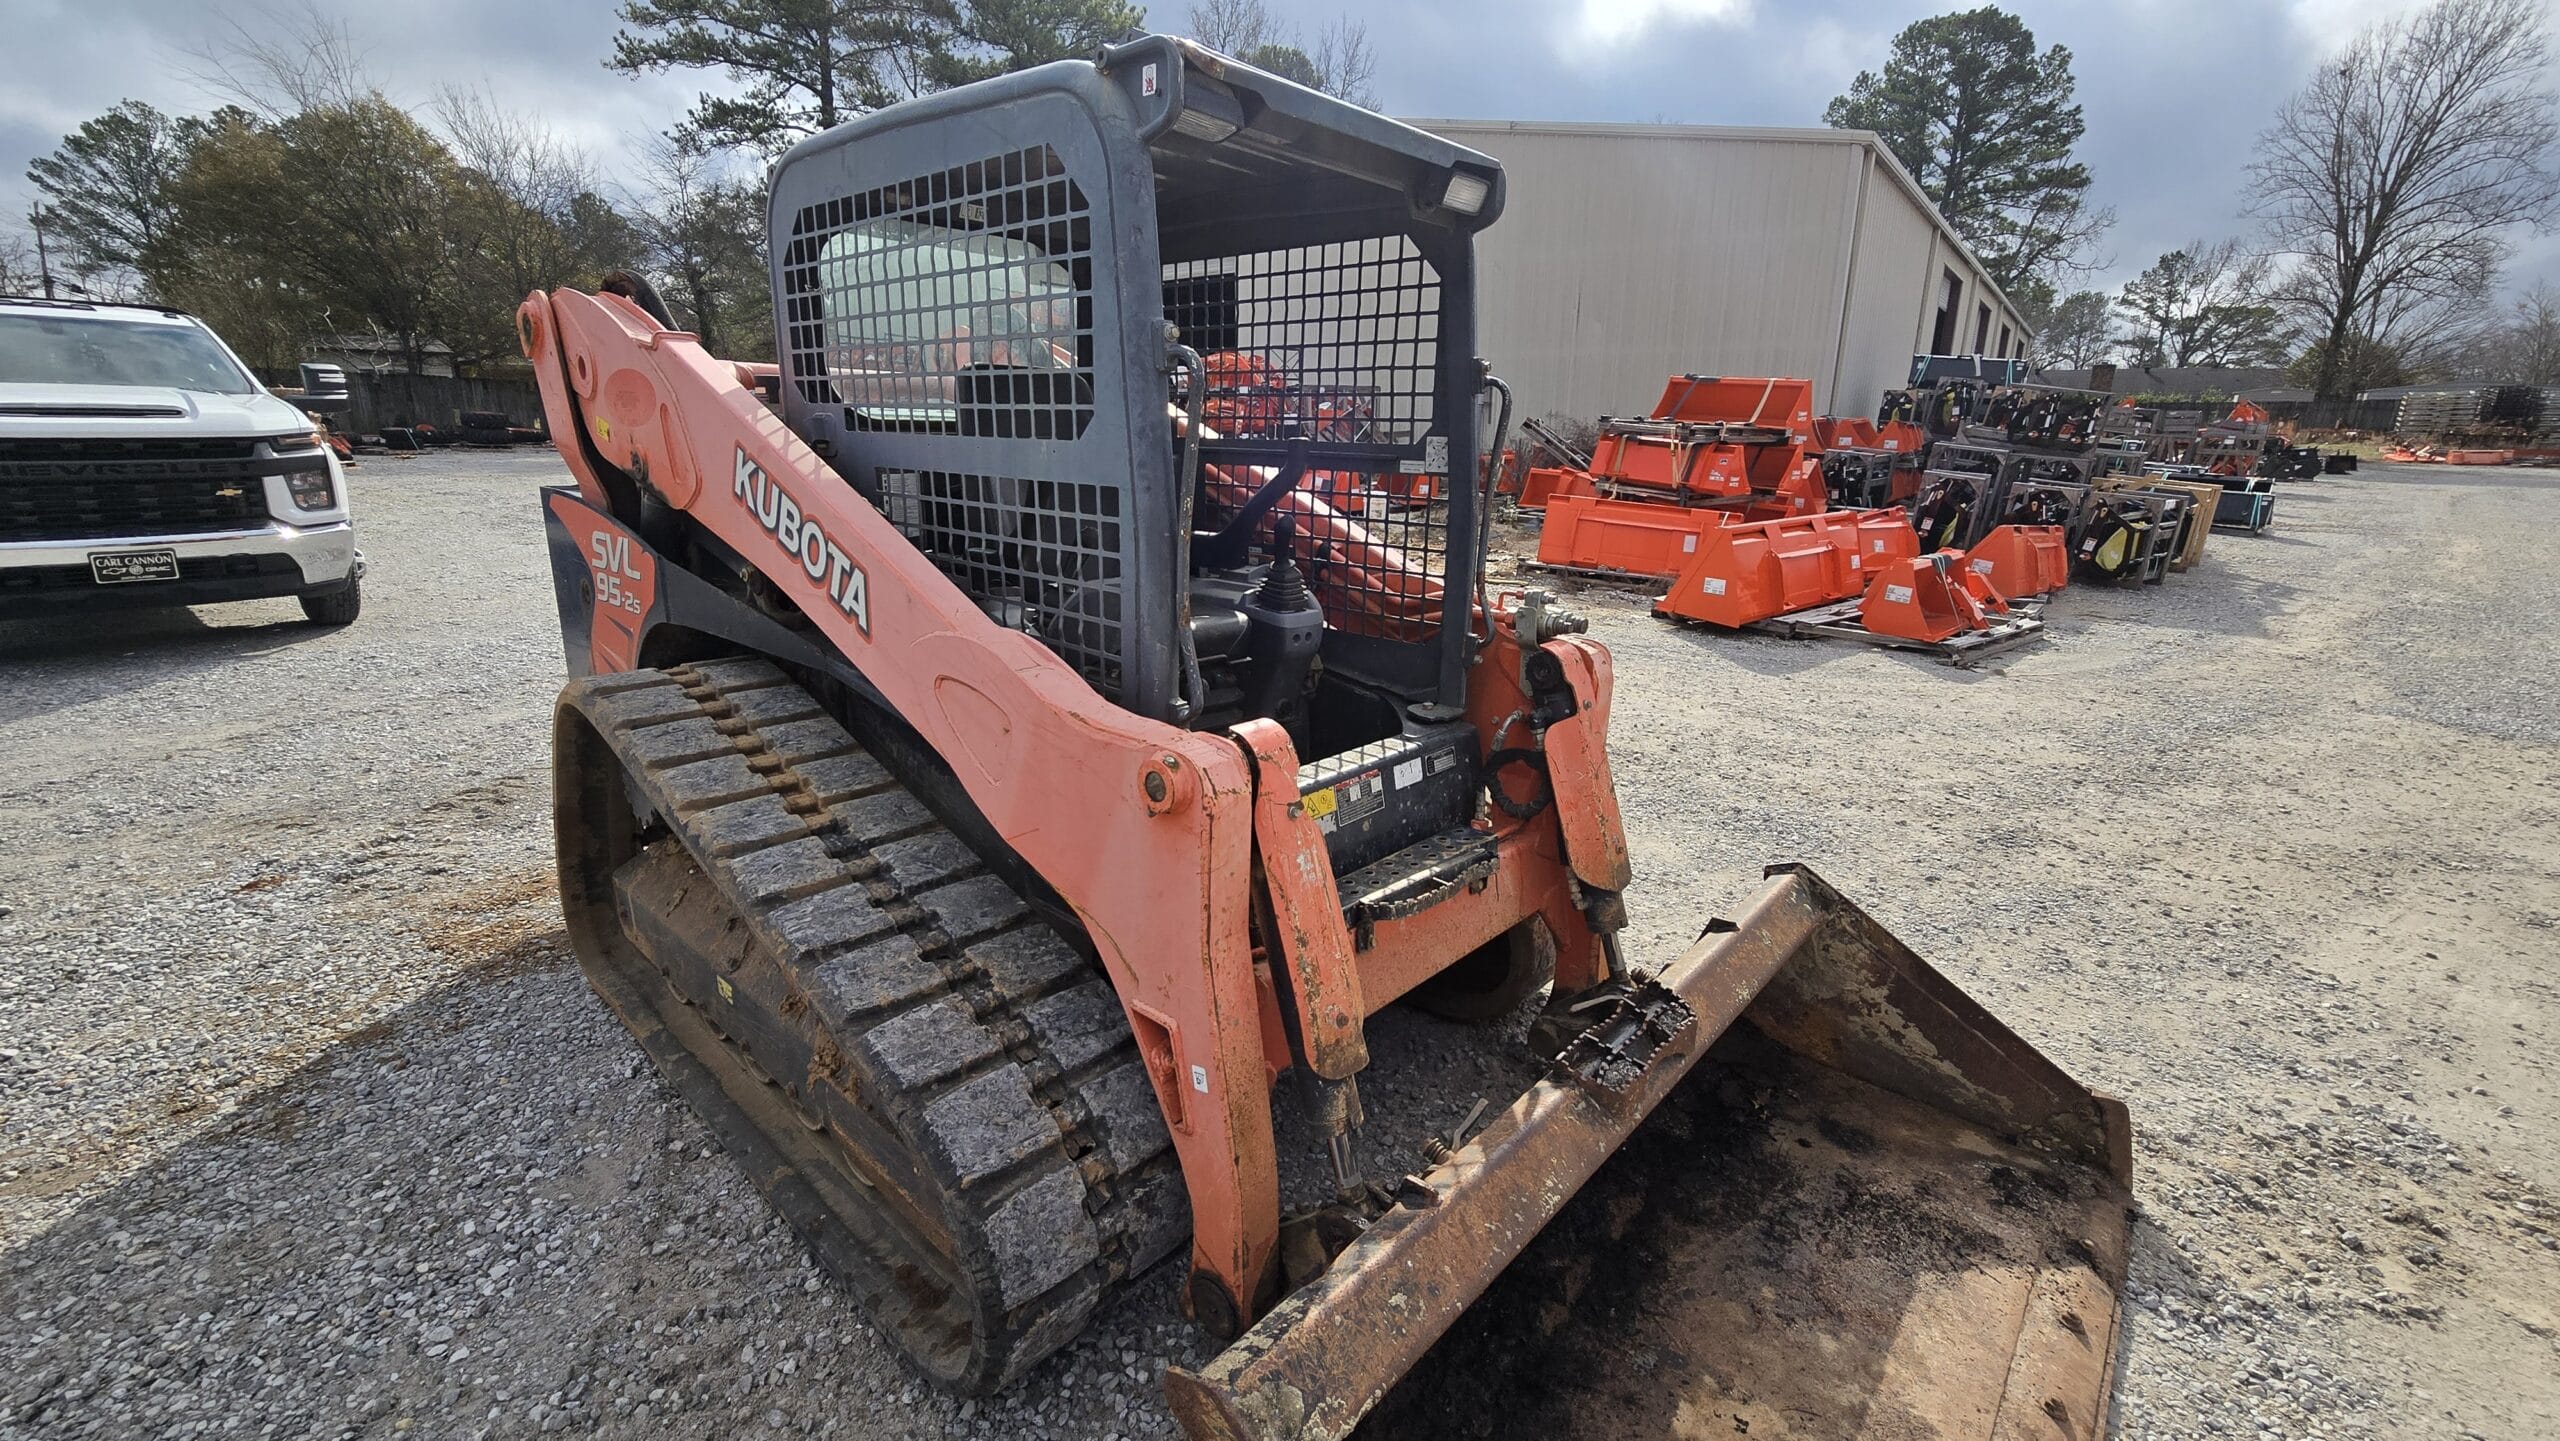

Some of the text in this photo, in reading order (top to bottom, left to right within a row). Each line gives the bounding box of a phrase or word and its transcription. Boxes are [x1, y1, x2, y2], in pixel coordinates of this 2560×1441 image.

[96, 555, 172, 567] CARL CANNON
[592, 530, 641, 580] SVL
[735, 447, 869, 634] KUBOTA
